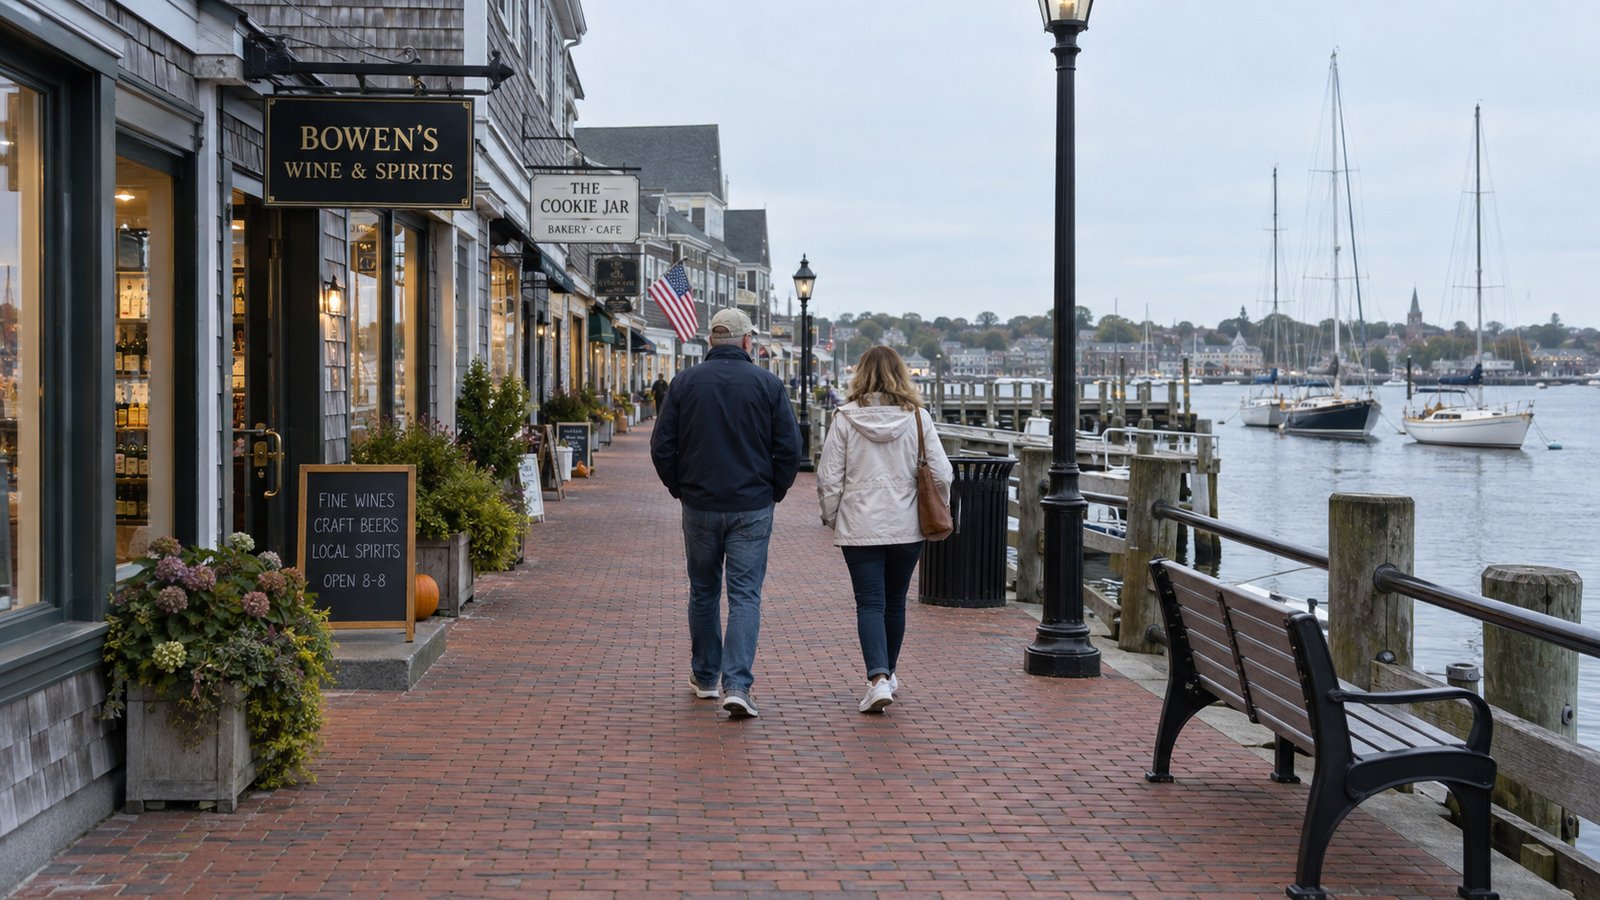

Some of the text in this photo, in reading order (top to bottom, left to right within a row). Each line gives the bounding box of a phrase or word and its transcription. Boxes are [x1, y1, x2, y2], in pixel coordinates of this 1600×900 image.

[300, 124, 439, 152] BOWEN'S
[284, 161, 453, 181] WINE & SPIRITS
[570, 182, 600, 195] THE
[540, 198, 630, 215] COOKIE JAR
[547, 224, 622, 235] BAKERY CAFE
[318, 492, 395, 508] FINE WINES
[313, 517, 399, 533] CRAFT BEERS
[312, 543, 401, 559] LOCAL SPIRITS
[323, 573, 386, 588] OPEN 8-8
